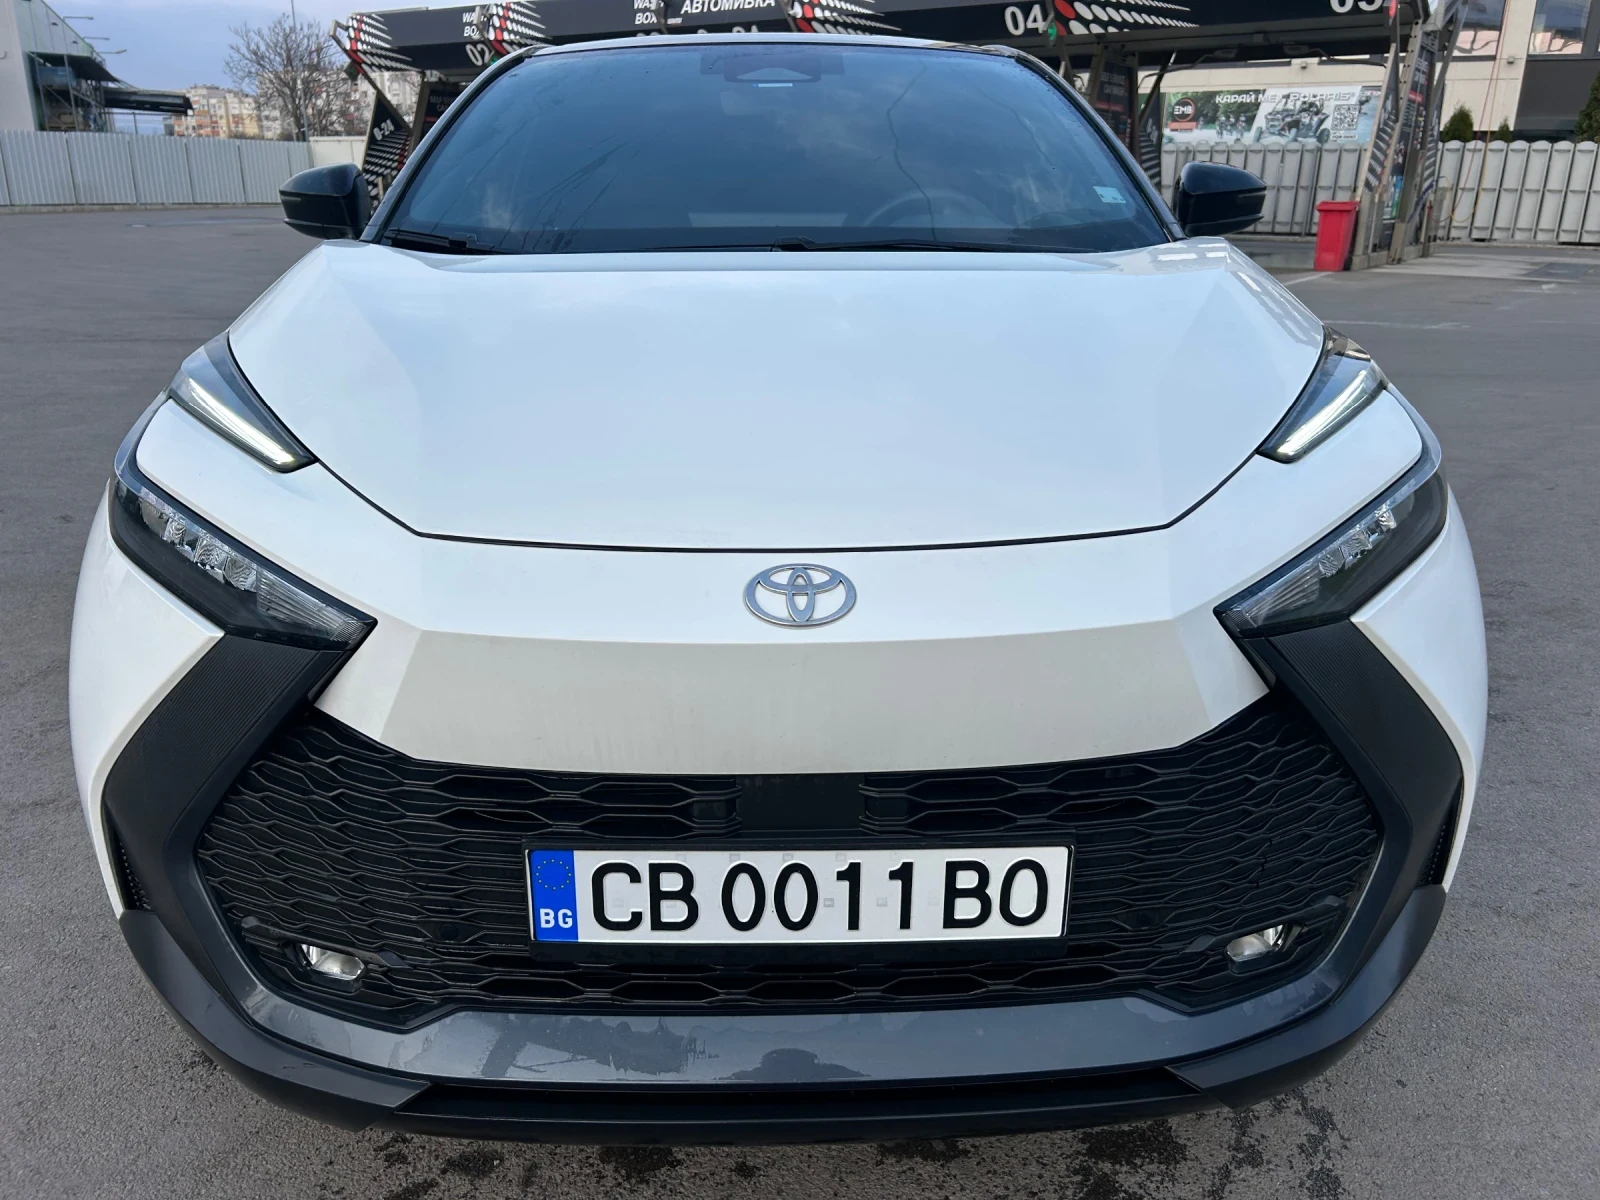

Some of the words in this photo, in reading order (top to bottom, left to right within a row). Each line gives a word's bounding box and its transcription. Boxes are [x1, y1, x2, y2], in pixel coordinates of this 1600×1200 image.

[1004, 4, 1048, 36] 04
[464, 25, 480, 37] BO
[1215, 91, 1255, 104] КАРАЙ
[592, 861, 699, 931] CB
[721, 861, 914, 932] 0011
[539, 908, 573, 929] BG
